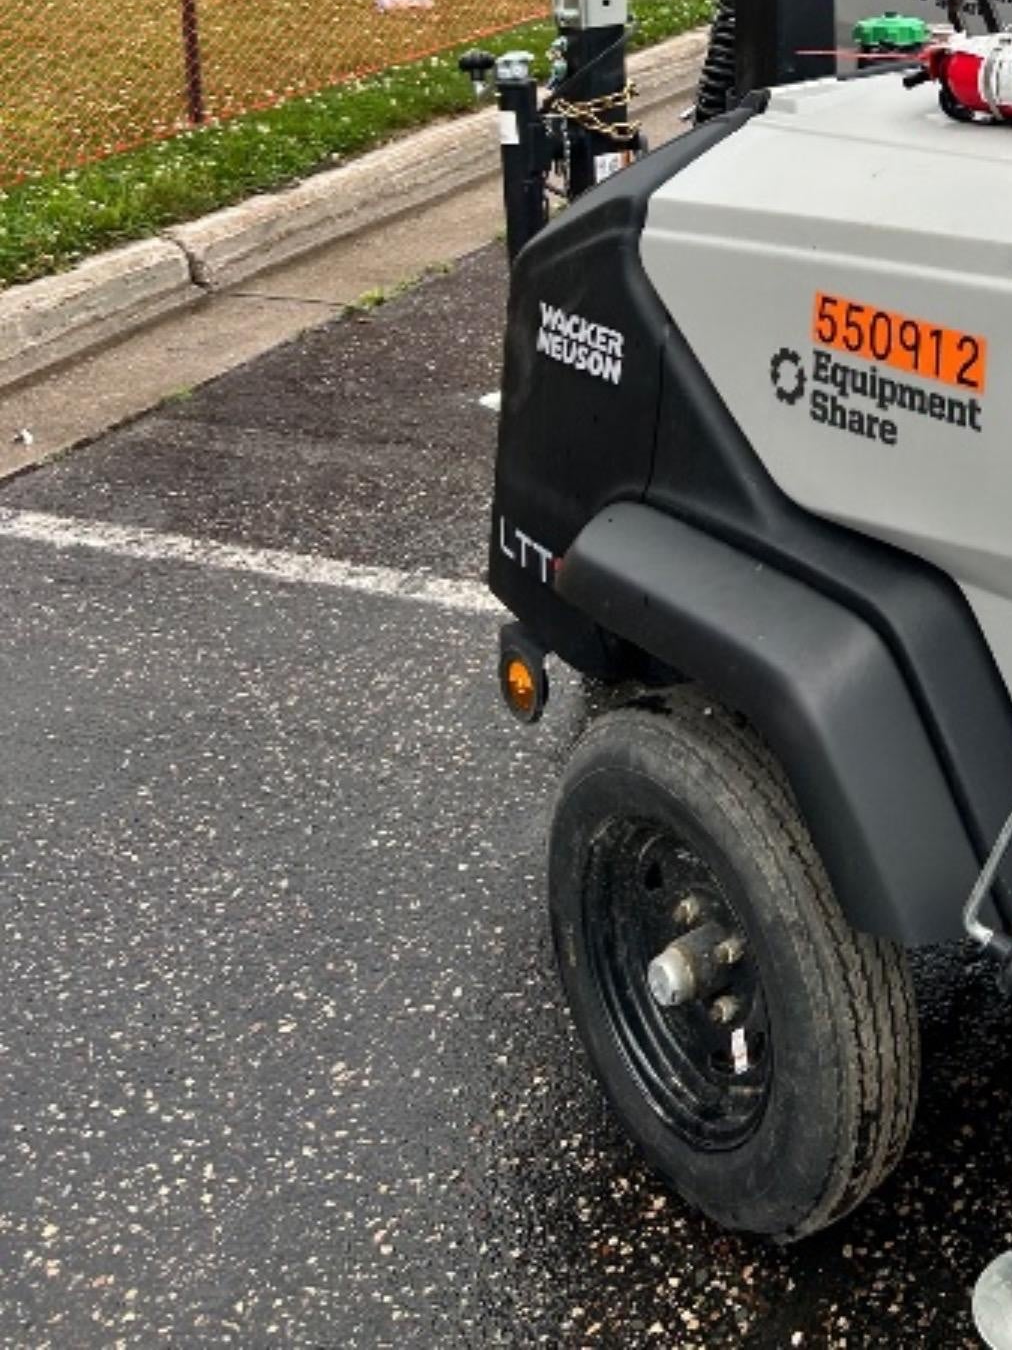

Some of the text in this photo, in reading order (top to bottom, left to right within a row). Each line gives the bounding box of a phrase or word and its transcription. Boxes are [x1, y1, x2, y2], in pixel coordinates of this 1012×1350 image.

[536, 326, 622, 385] NEUSON
[539, 301, 624, 358] WACKER
[816, 296, 979, 388] 550912
[810, 390, 897, 445] Share
[811, 349, 983, 432] Equipment
